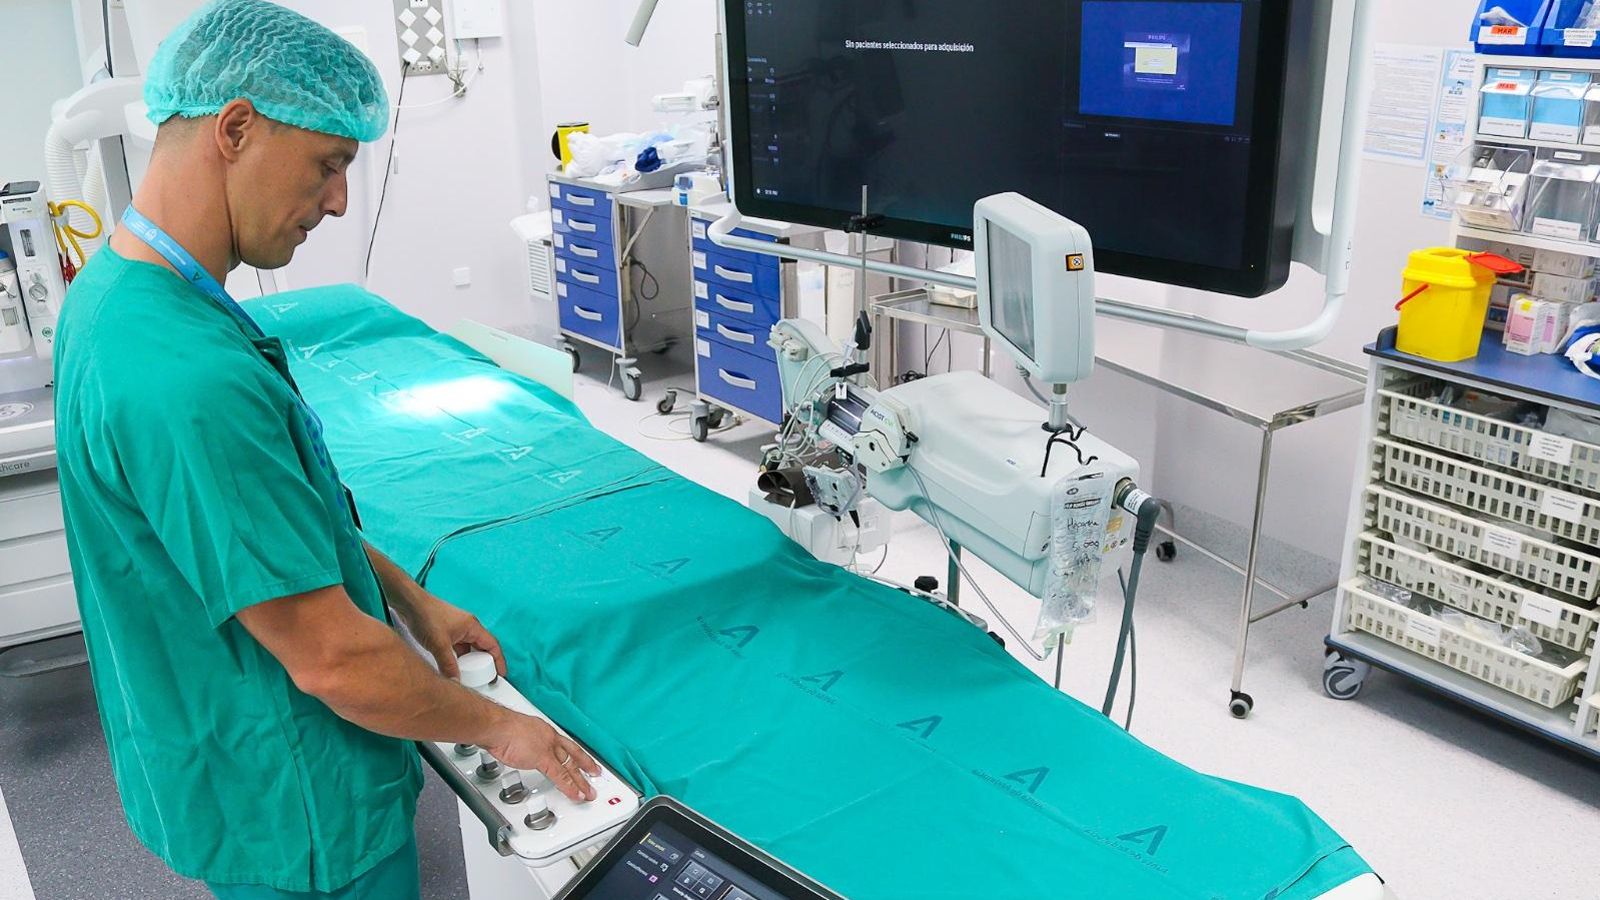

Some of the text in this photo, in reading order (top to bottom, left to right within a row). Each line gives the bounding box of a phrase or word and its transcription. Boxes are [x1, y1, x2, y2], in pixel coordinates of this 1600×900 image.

[845, 40, 975, 53] Sin pacientes seleccionados para adquisición
